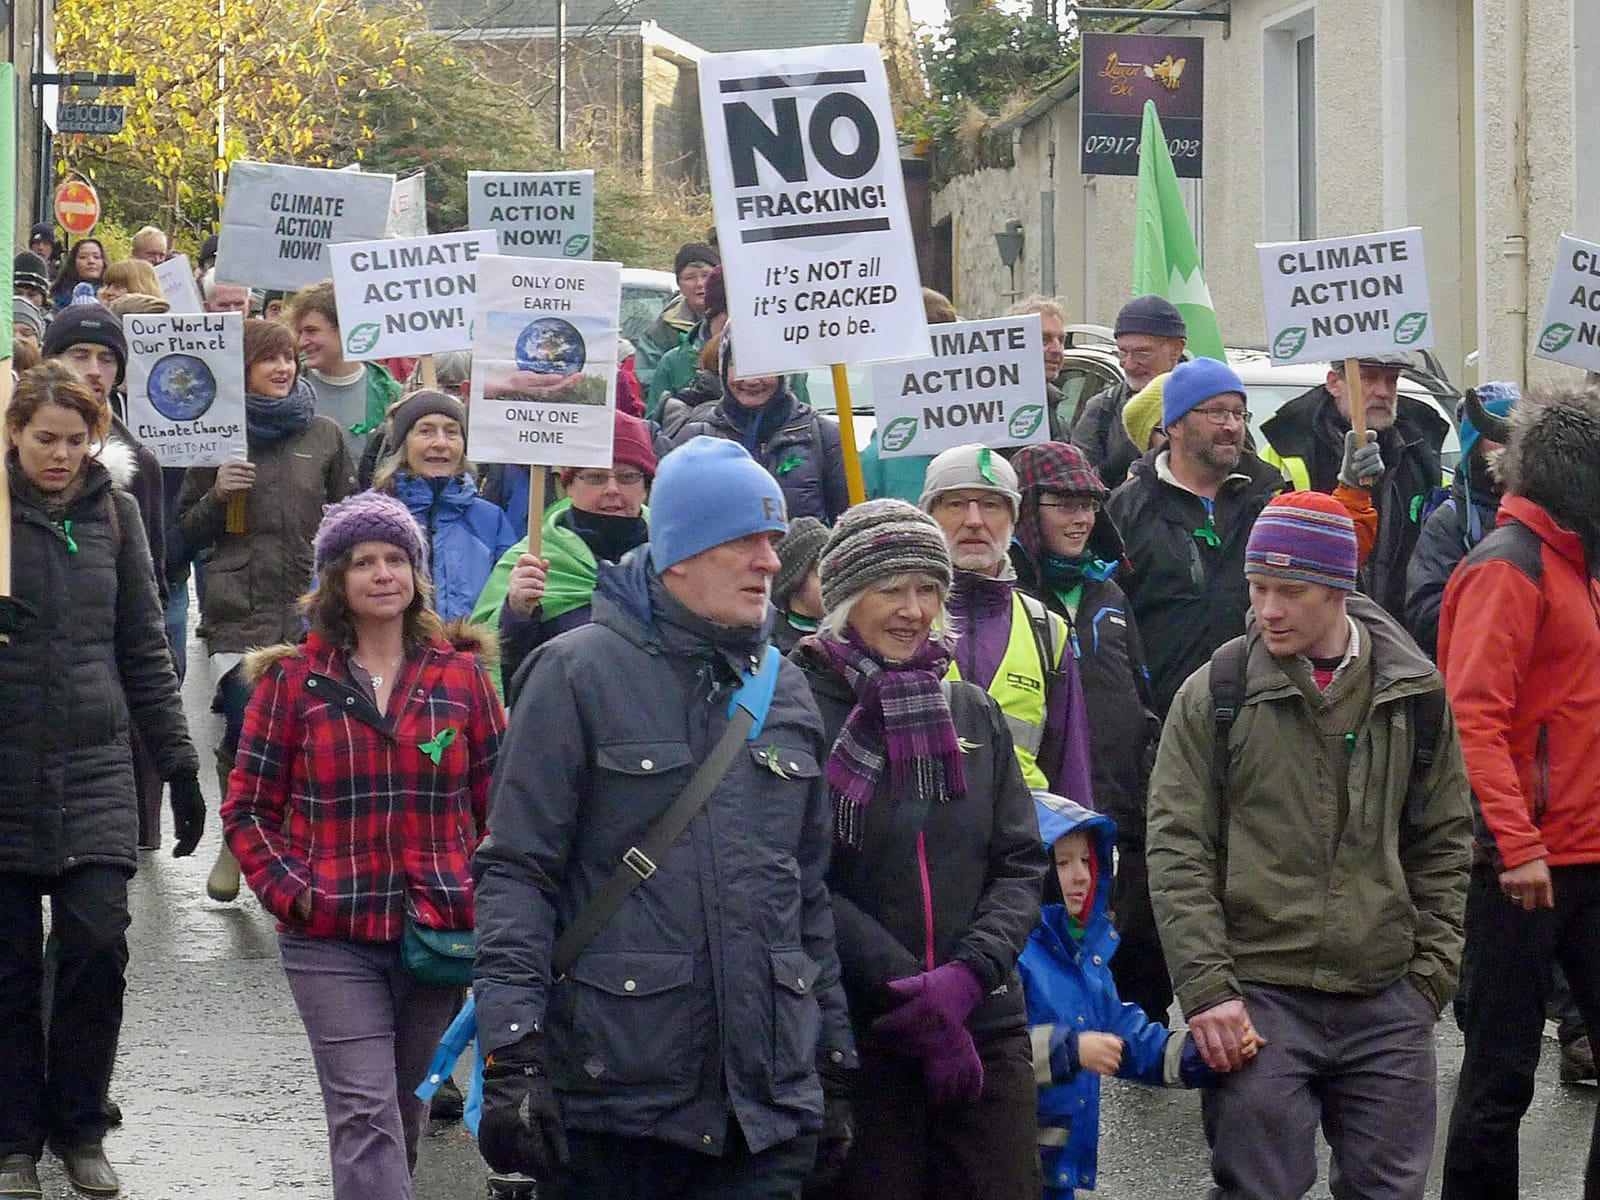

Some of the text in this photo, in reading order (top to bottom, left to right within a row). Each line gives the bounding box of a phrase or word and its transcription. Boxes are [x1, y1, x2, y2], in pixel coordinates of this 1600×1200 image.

[722, 92, 880, 188] NO
[1085, 135, 1137, 155] 07917
[484, 181, 581, 197] CLIMATE
[271, 192, 344, 217] CLIMATE
[489, 205, 575, 221] ACTION
[736, 185, 887, 220] FRACKING!
[275, 216, 332, 239] ACTION
[504, 230, 561, 245] NOW!
[279, 240, 322, 260] NOW!
[350, 241, 480, 272] CLIMATE
[1278, 240, 1408, 275] CLIMATE
[512, 275, 585, 291] ONLY ONE
[765, 257, 881, 287] It's NOT all
[363, 274, 476, 304] ACTION
[754, 285, 897, 317] it's CRACKED
[1290, 274, 1404, 308] ACTION
[524, 297, 571, 311] EARTH
[132, 316, 224, 335] Our World
[385, 307, 465, 334] NOW!
[784, 315, 876, 344] up to be.
[1311, 309, 1390, 338] NOW!
[132, 334, 225, 354] Our Planet
[931, 327, 1026, 357] IMATE
[901, 363, 1020, 396] ACTION
[505, 408, 579, 424] ONLY ONE
[923, 400, 1005, 430] NOW!
[139, 423, 192, 438] Climate
[519, 430, 564, 444] HOME
